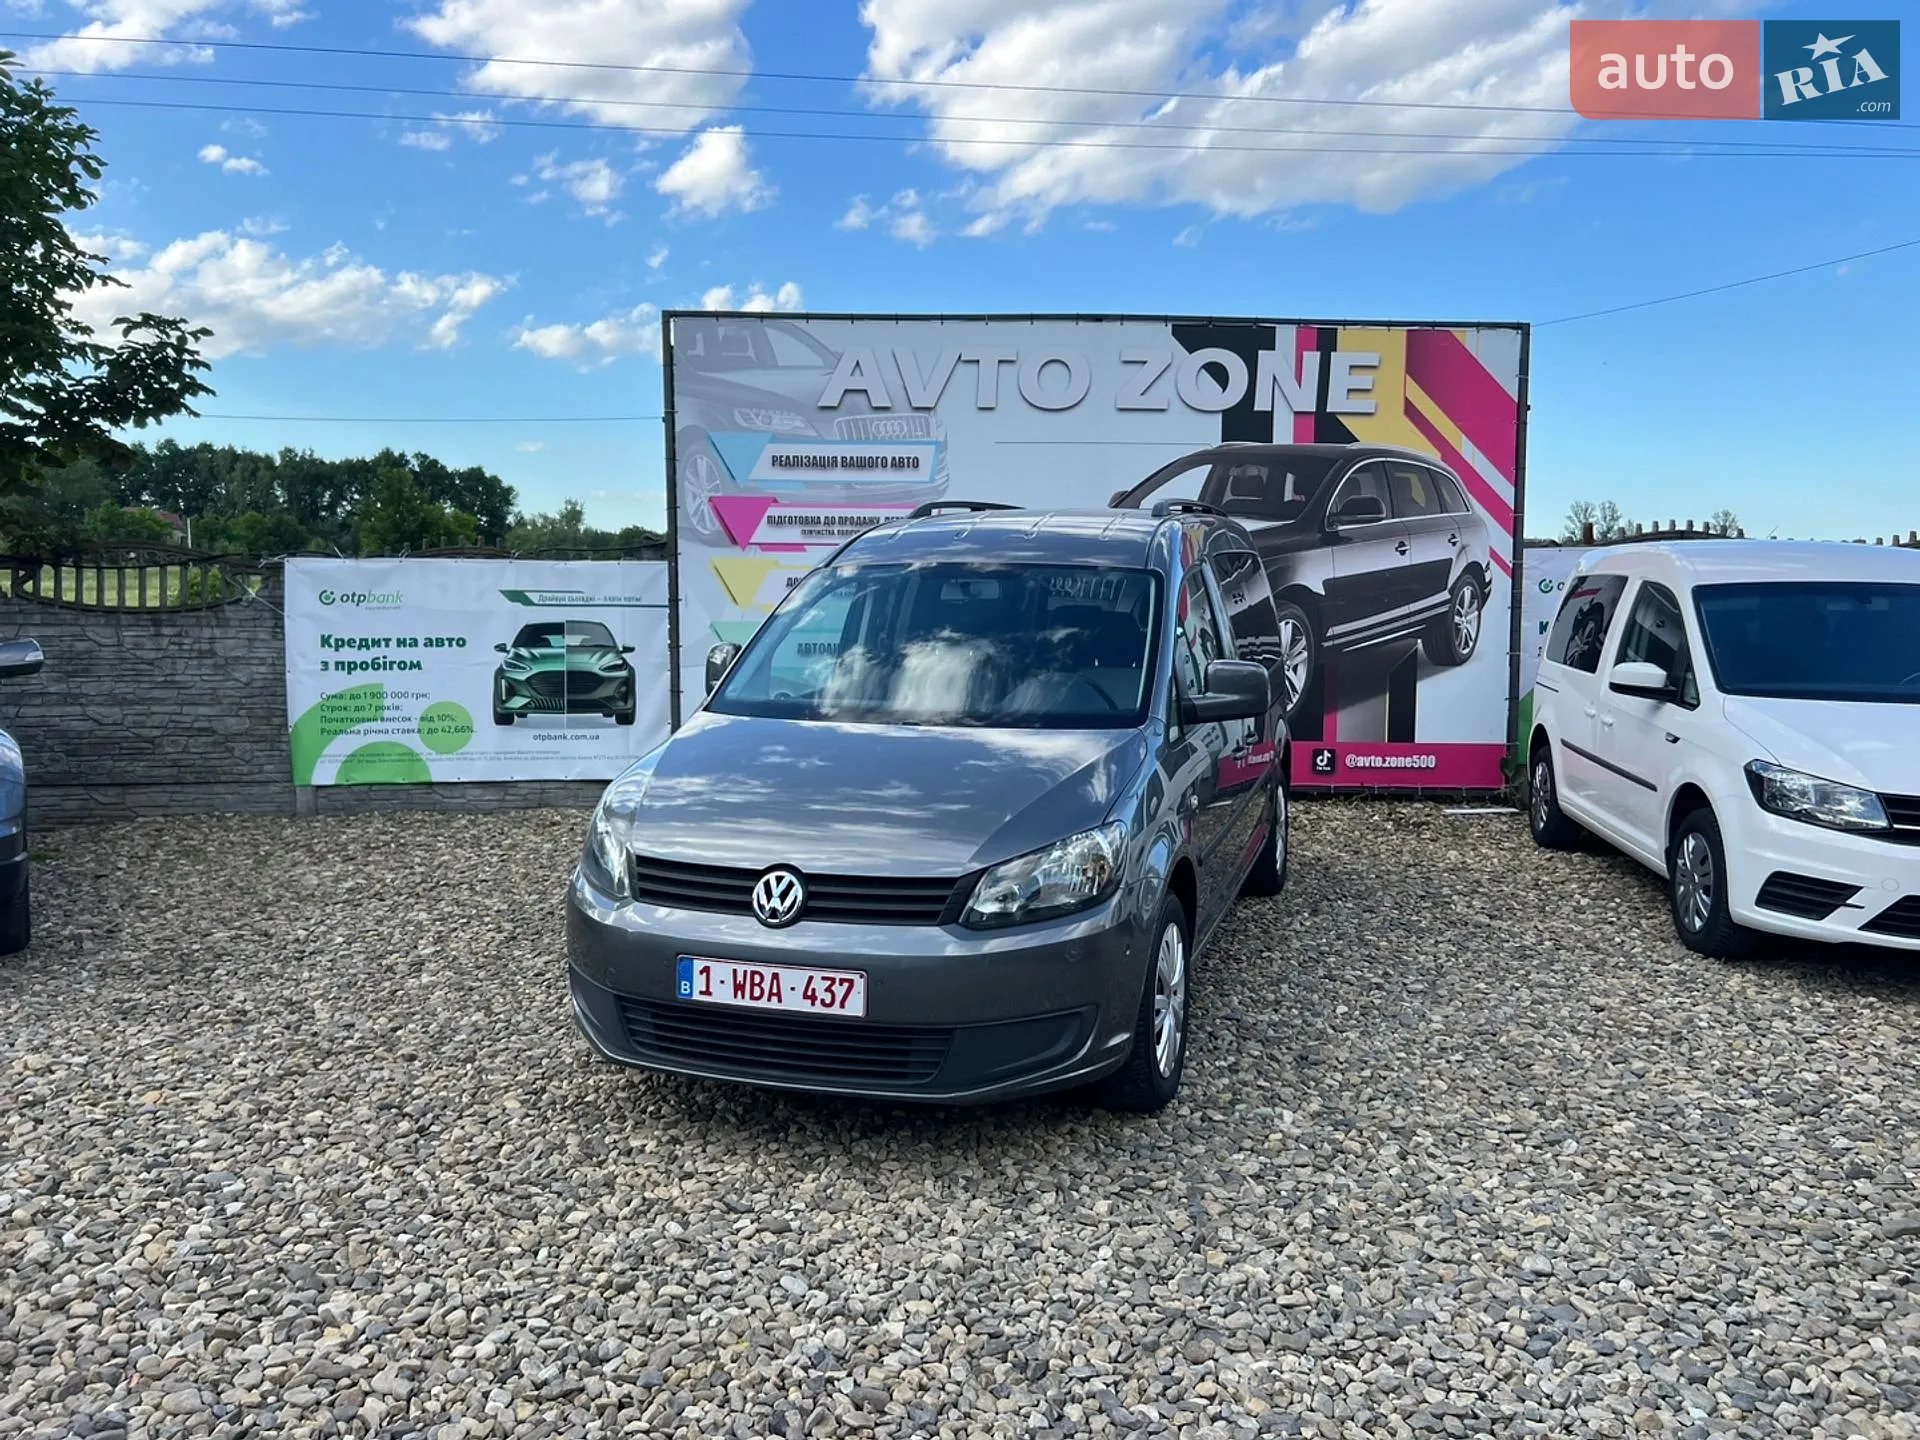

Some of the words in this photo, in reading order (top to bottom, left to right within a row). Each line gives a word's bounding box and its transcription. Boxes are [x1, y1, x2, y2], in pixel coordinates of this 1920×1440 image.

[817, 345, 1092, 411] AVTO
[1115, 346, 1382, 415] ZONE
[771, 454, 838, 469] РЕАЛІЗАЦІЯ
[841, 455, 888, 469] ВАШОГО
[891, 456, 919, 469] АВТО
[766, 514, 821, 527] ПІДГОТОВКА
[823, 515, 836, 527] ДО
[340, 590, 403, 606] otpbank
[320, 634, 392, 652] Кредит
[396, 636, 419, 648] на
[423, 636, 467, 648] авто
[320, 660, 329, 671] з
[334, 655, 423, 675] пробігом
[320, 691, 347, 701] Сума:
[349, 692, 361, 701] до
[320, 704, 351, 713] Строк:
[353, 705, 366, 713] до
[368, 704, 373, 712] 7
[320, 715, 378, 724] Початковий
[320, 727, 361, 735] Реальна
[363, 726, 389, 736] річна
[427, 727, 439, 735] до
[532, 733, 600, 743] otpbank.com.ua
[1345, 753, 1436, 768] @avto.zone500
[681, 981, 691, 994] B
